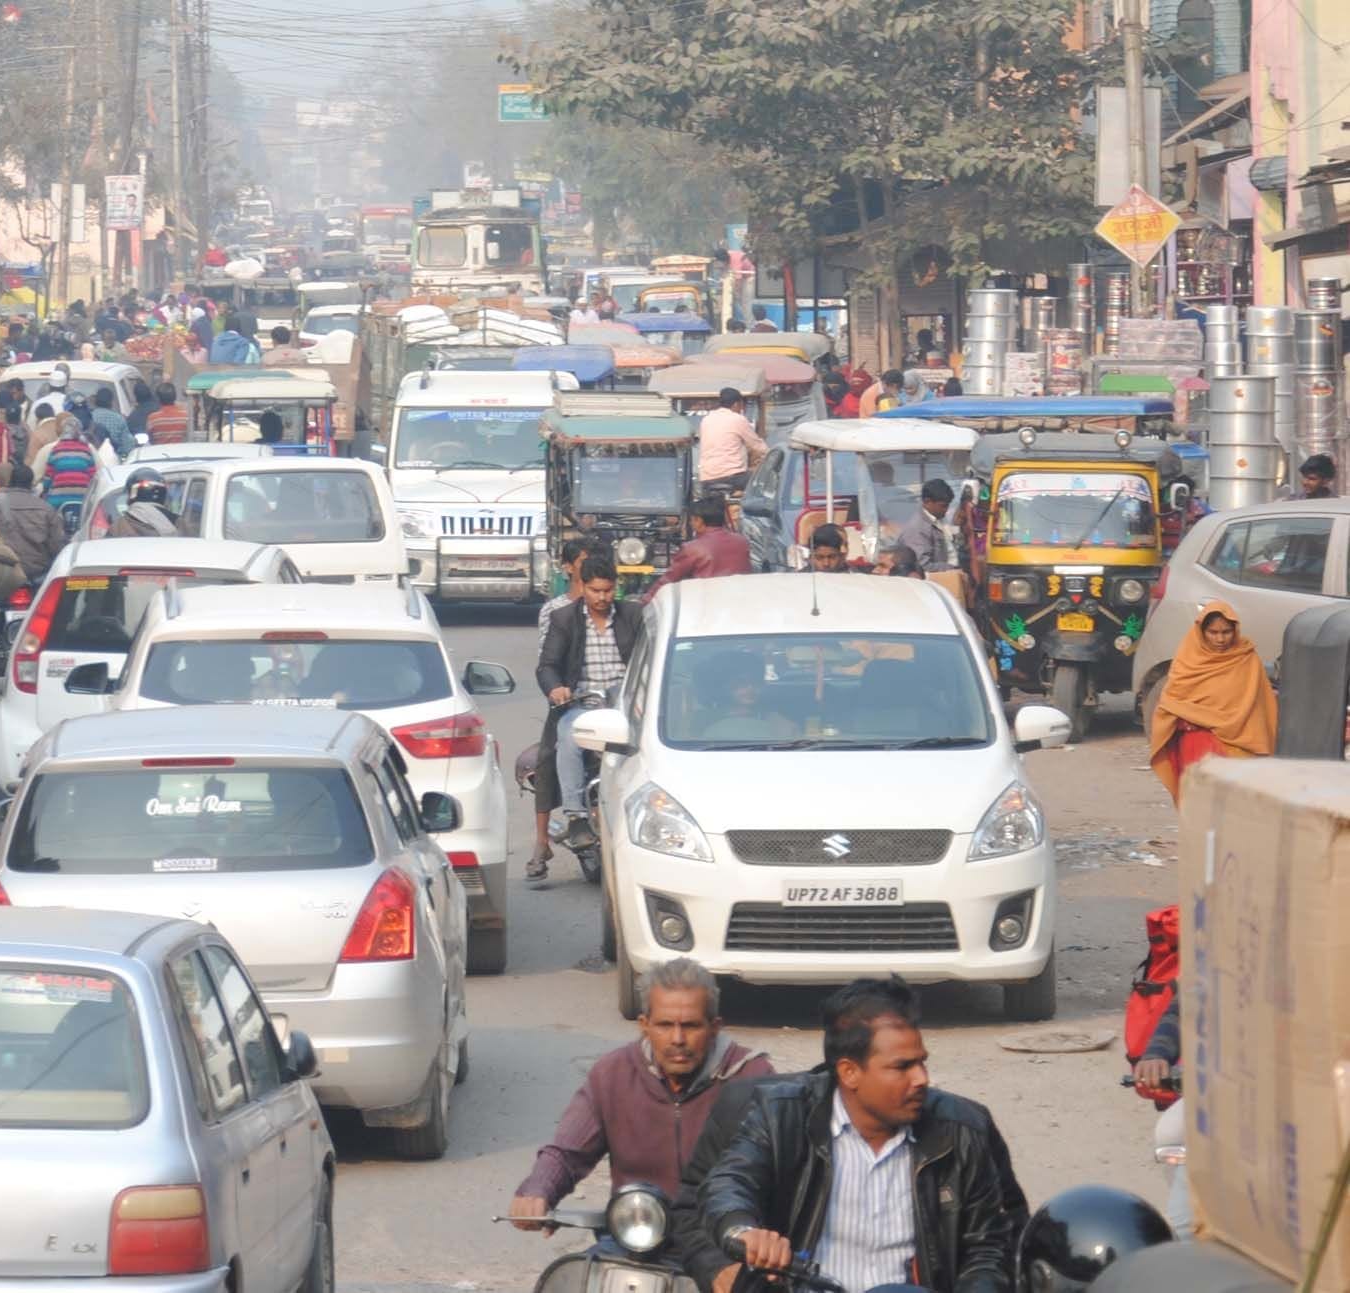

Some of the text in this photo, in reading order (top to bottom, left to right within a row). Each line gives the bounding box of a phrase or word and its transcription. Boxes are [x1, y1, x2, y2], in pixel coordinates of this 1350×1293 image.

[146, 795, 243, 816] Om Sai Ram
[787, 886, 900, 901] UP72 AF 3888
